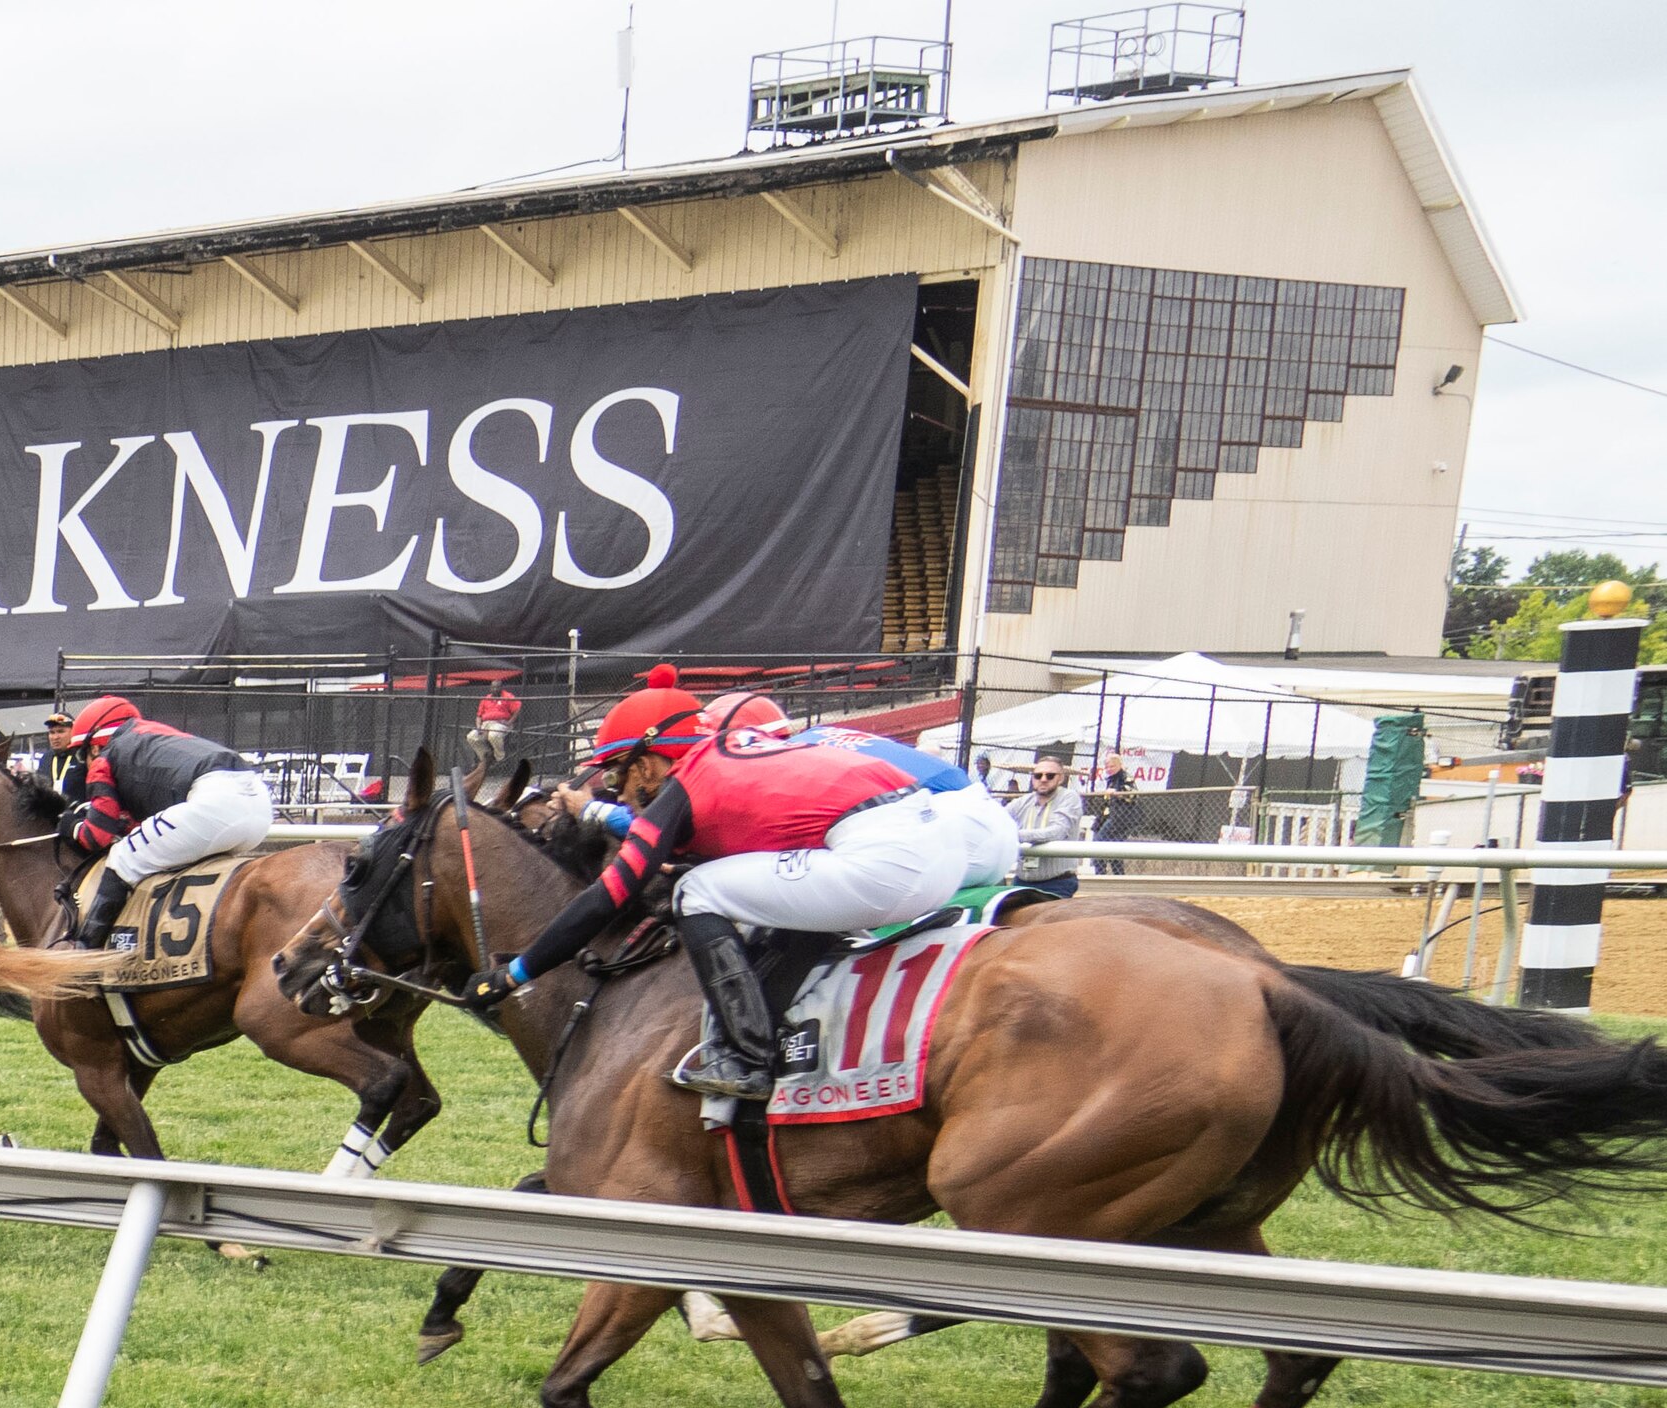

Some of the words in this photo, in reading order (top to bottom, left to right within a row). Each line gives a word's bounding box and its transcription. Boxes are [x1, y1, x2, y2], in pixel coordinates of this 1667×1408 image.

[1134, 766, 1166, 782] AID
[144, 873, 221, 961] 15
[118, 961, 200, 983] WAGONEER
[838, 943, 945, 1071] 11
[784, 1043, 816, 1063] BET
[773, 1075, 909, 1106] AGONEER
